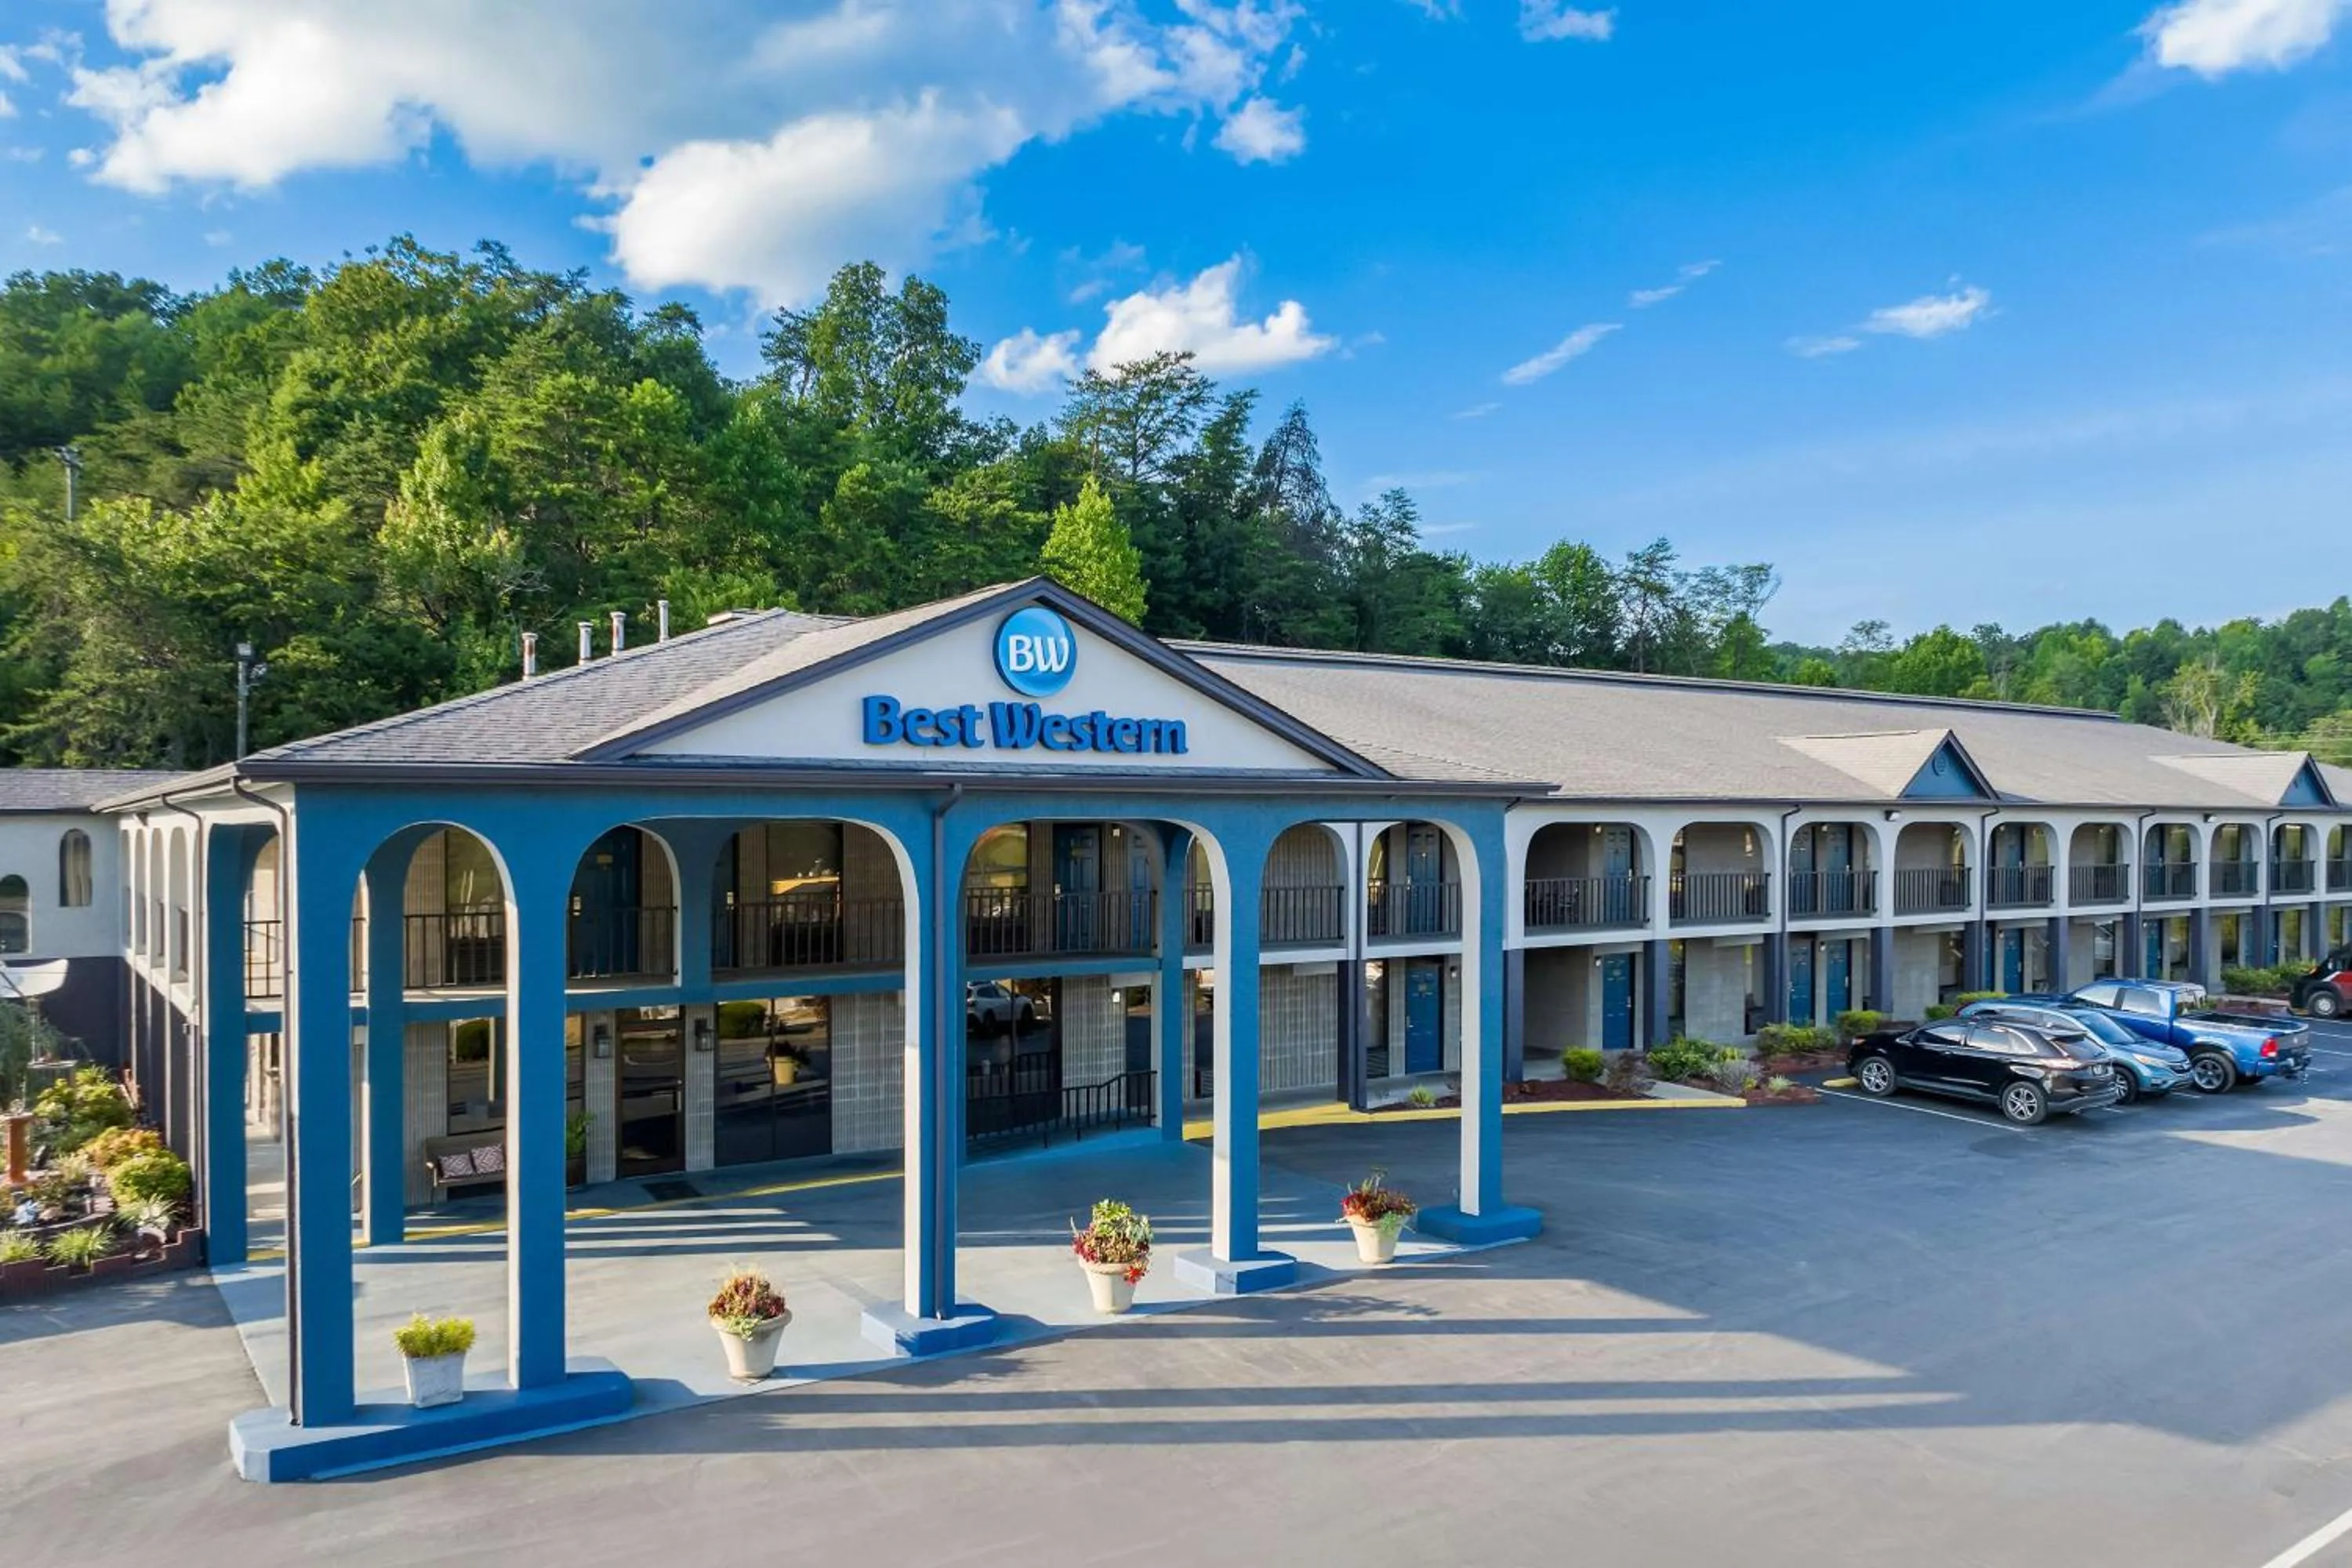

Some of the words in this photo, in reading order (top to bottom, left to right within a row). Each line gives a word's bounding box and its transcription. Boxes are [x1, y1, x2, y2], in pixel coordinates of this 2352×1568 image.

[1007, 634, 1069, 672] BW
[862, 695, 984, 748] Best
[989, 701, 1188, 754] Western
